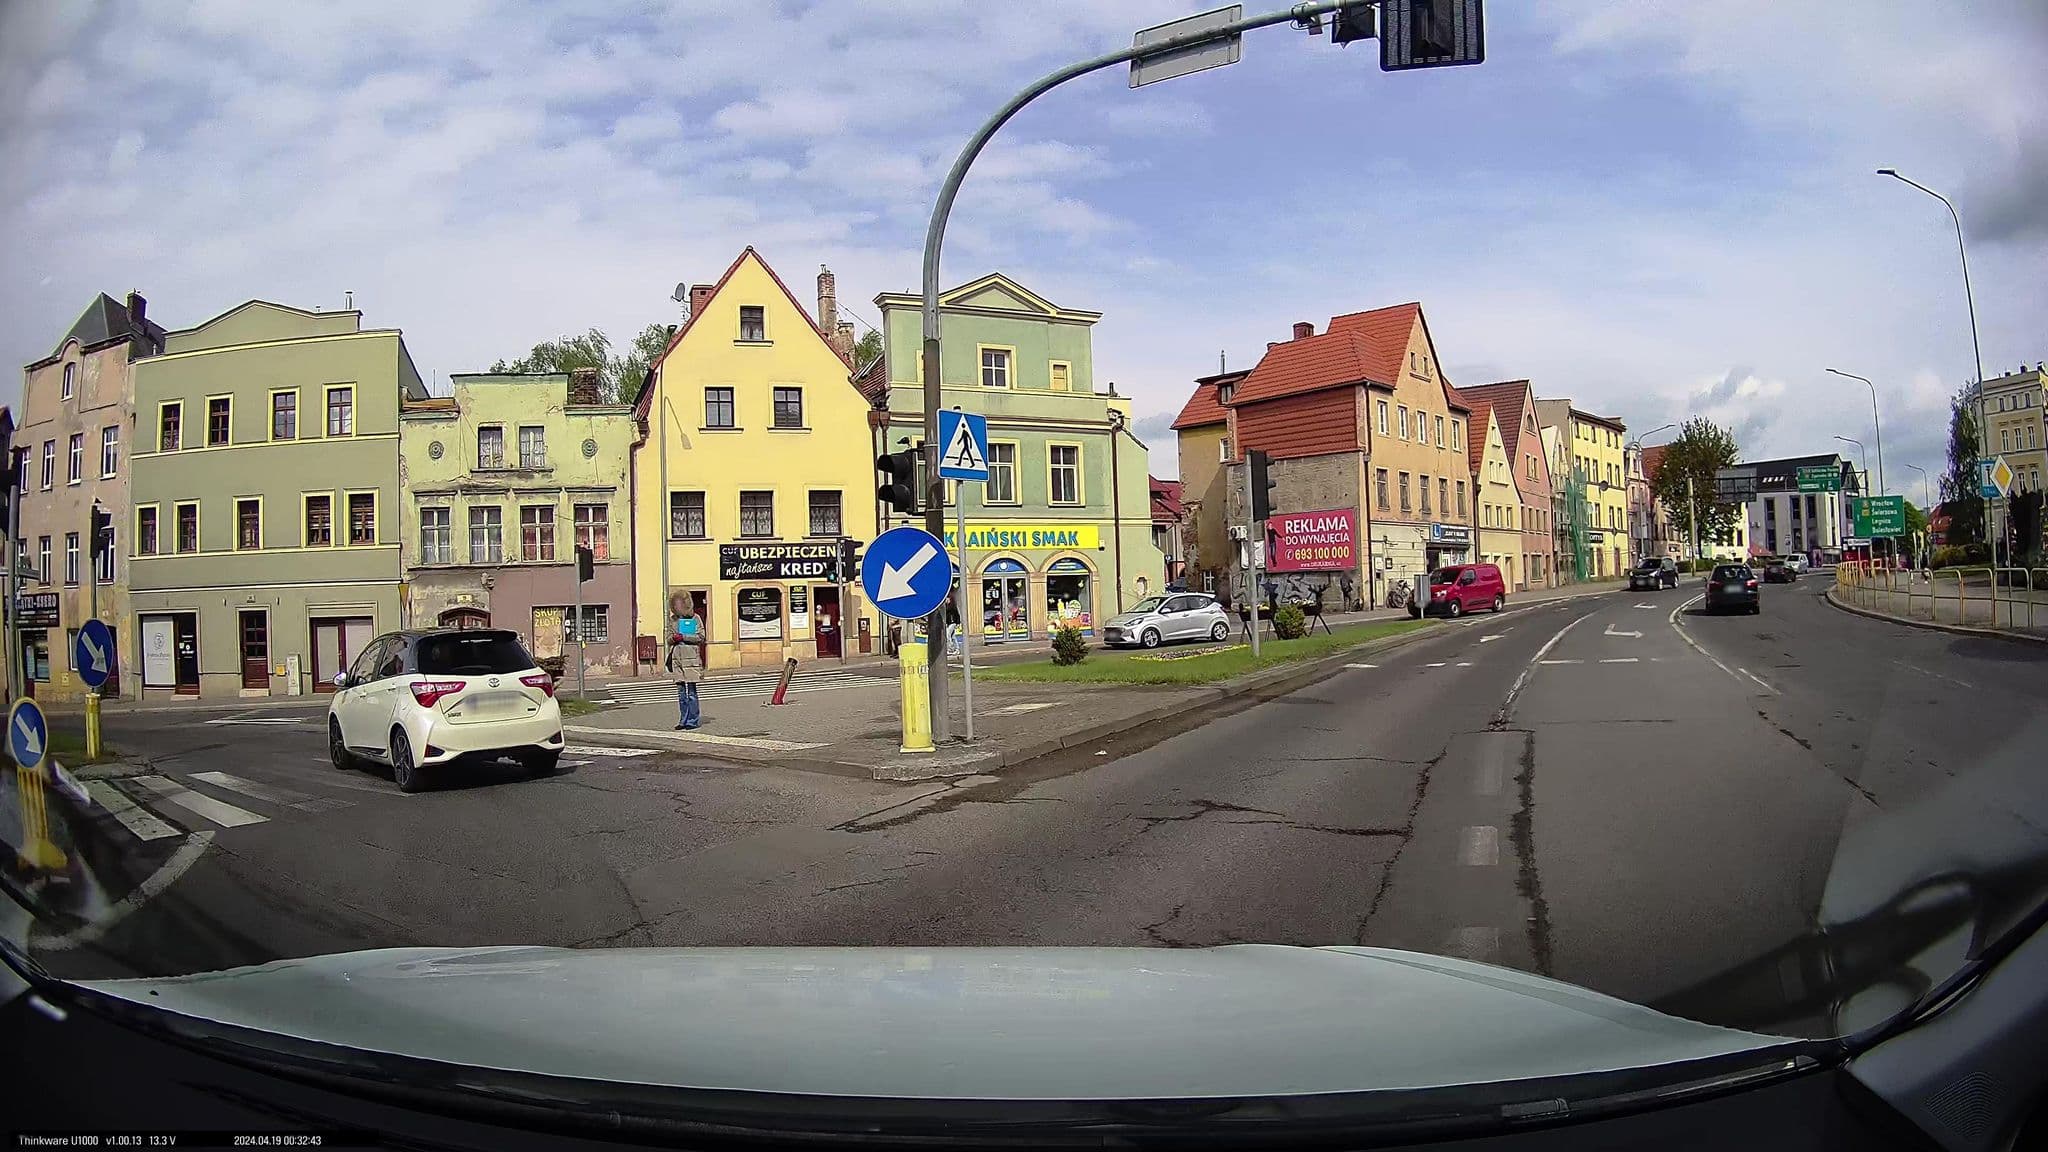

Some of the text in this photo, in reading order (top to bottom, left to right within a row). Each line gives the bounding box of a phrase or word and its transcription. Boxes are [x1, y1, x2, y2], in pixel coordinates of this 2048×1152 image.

[1285, 516, 1349, 534] REKLAMA
[1032, 531, 1079, 546] SMAK
[1285, 532, 1350, 545] DO WYNAJĘCIA
[740, 545, 846, 559] UBEZPIECZEN
[1295, 545, 1349, 560] 693 100 000
[725, 562, 842, 579] najtańsze KRED
